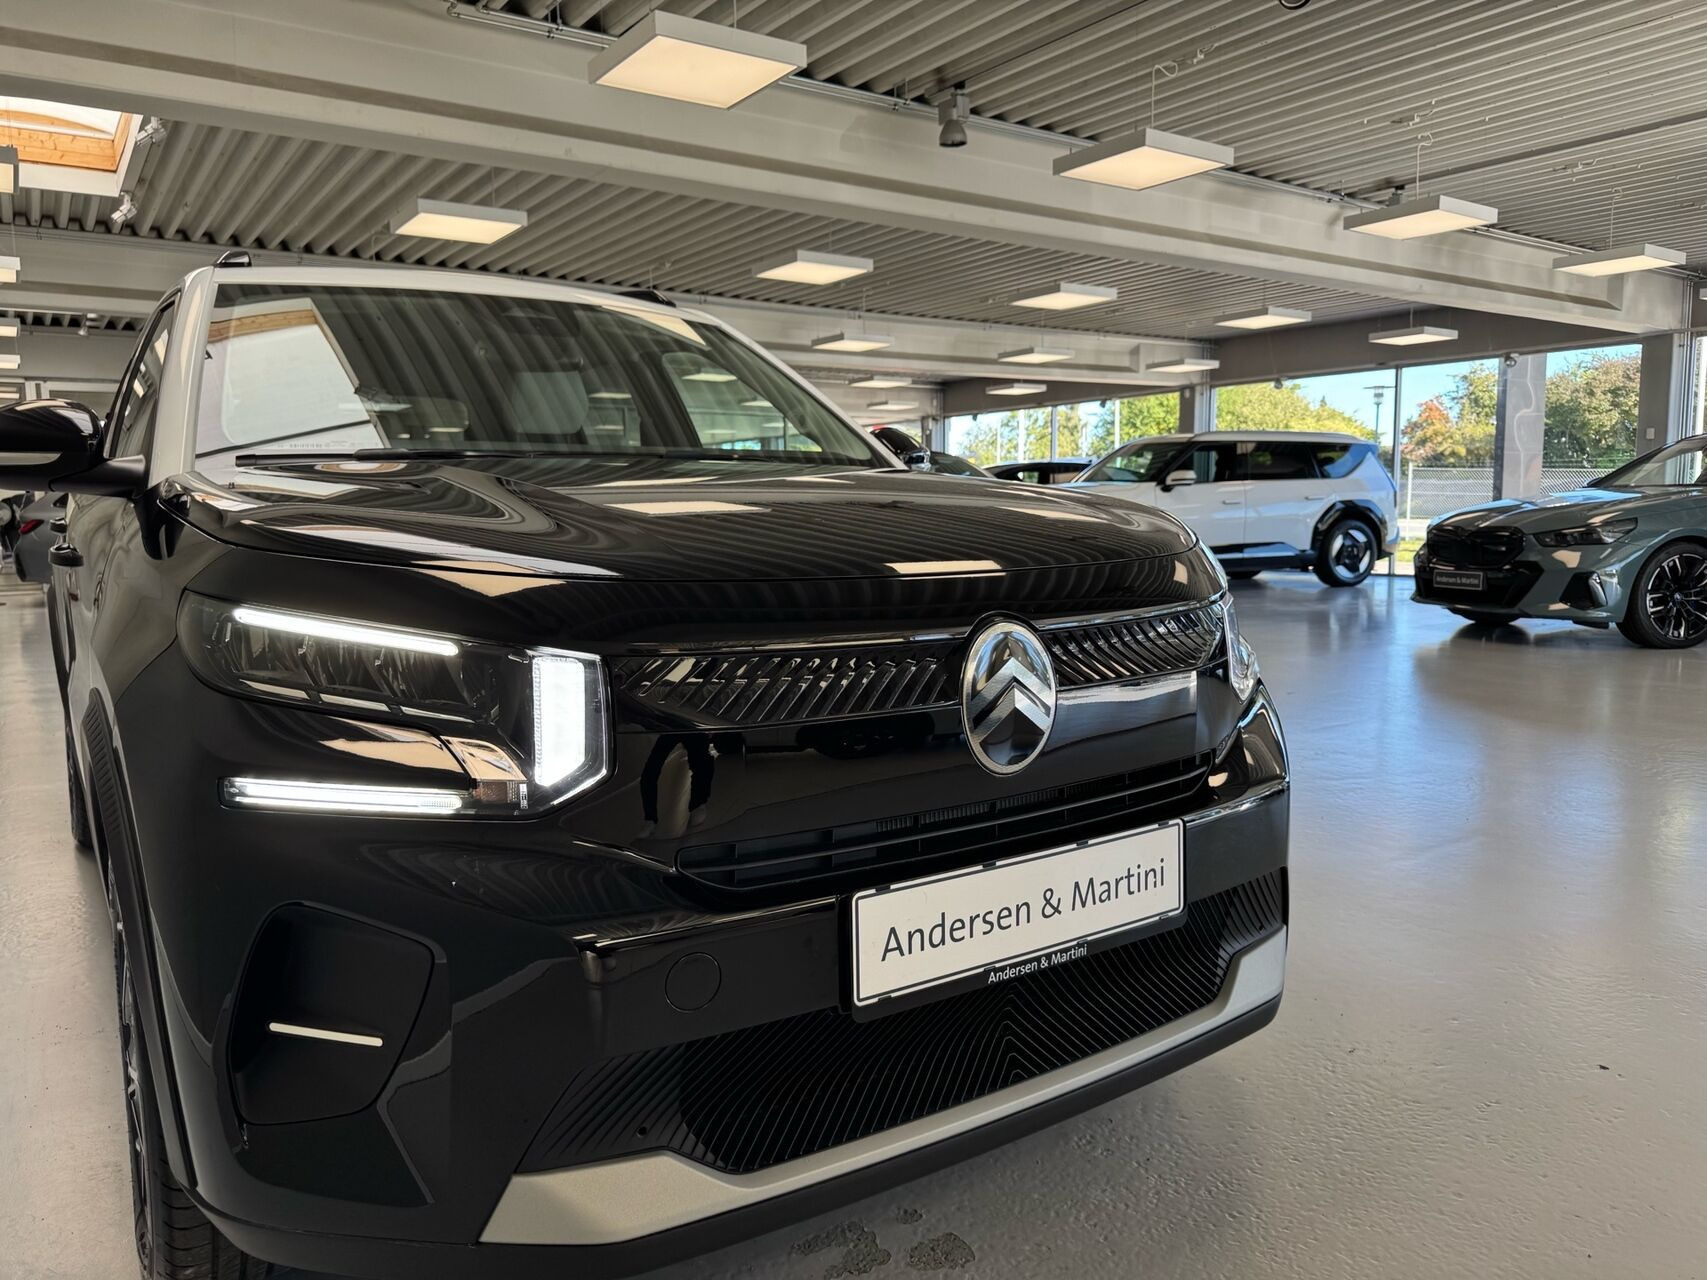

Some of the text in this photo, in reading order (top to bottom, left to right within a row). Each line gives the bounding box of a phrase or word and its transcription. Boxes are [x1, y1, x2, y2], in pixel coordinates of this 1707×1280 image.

[880, 857, 1165, 963] Andersen & Martini
[987, 944, 1088, 984] Andersen & Martini
